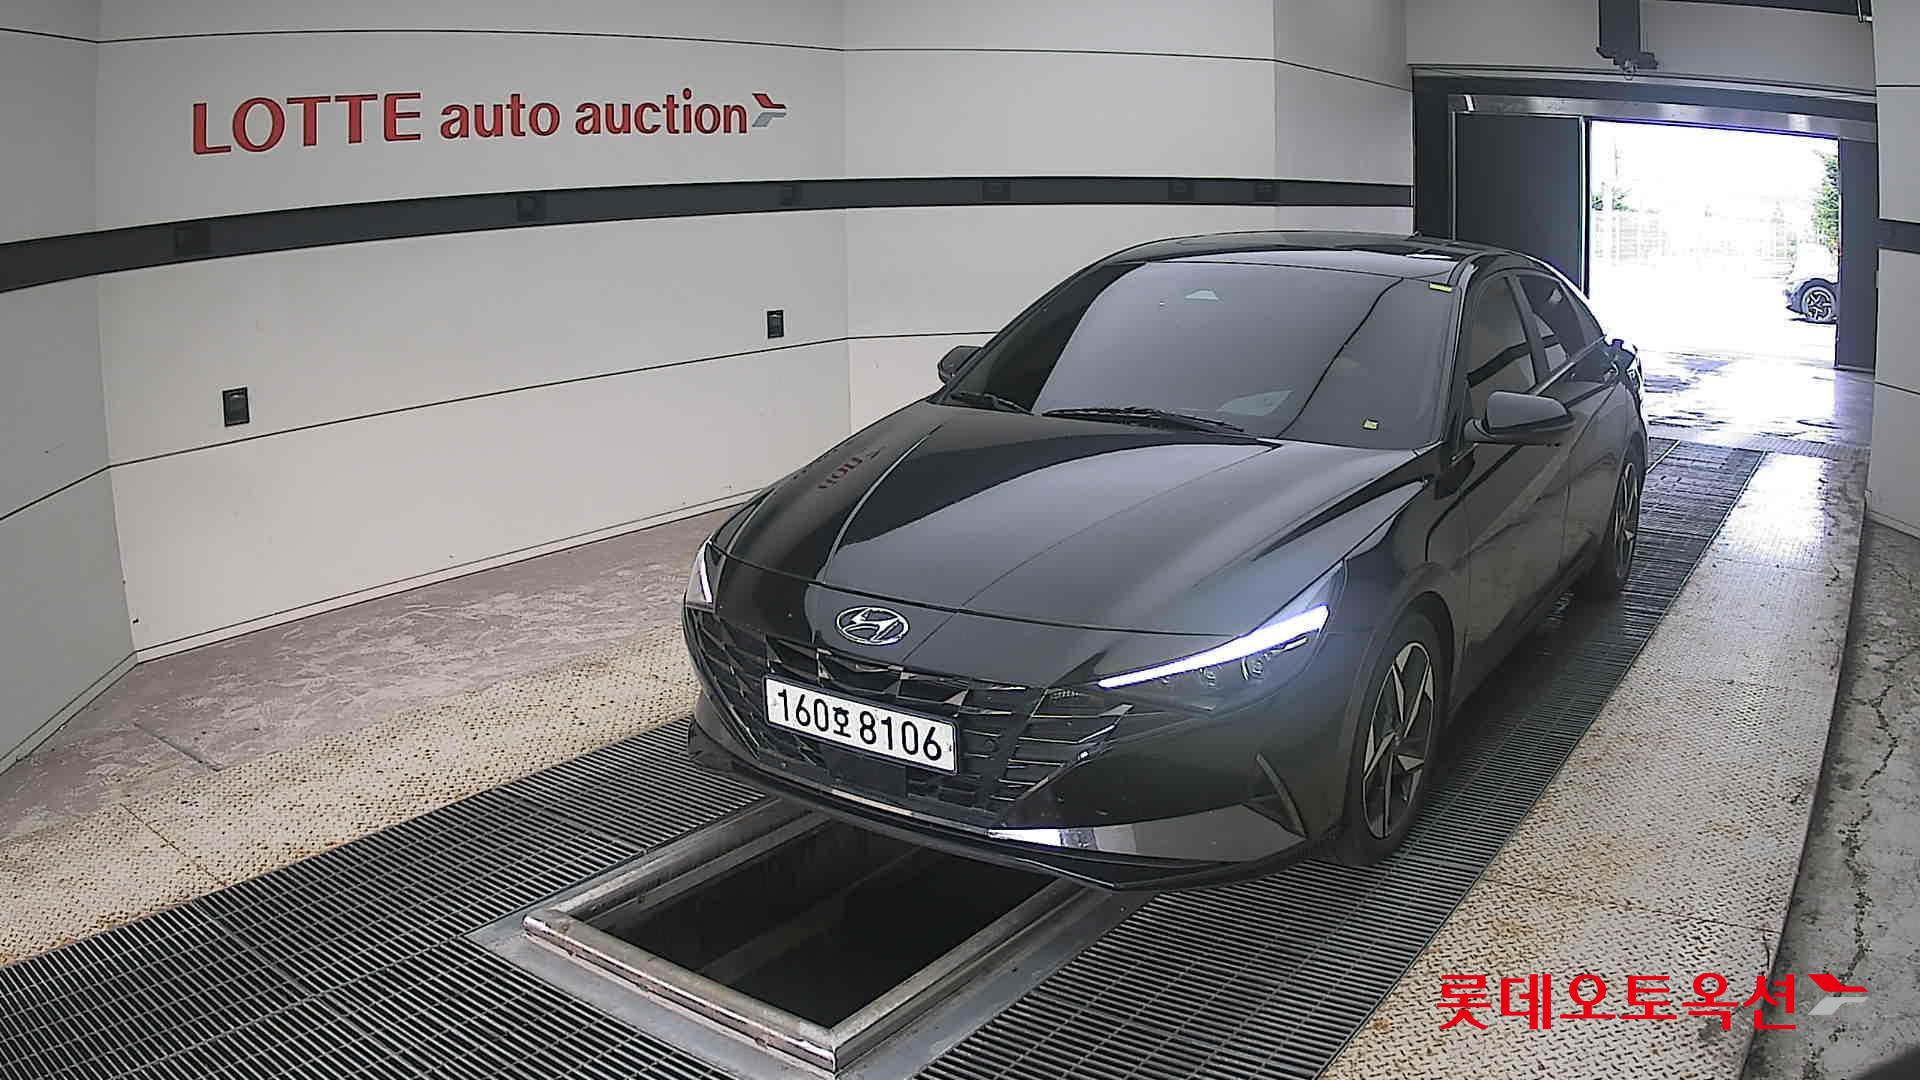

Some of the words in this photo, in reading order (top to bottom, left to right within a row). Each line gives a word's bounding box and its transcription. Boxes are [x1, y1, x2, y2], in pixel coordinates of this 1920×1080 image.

[192, 93, 421, 154] LOTTE
[440, 94, 560, 138] auto
[575, 89, 747, 134] auction
